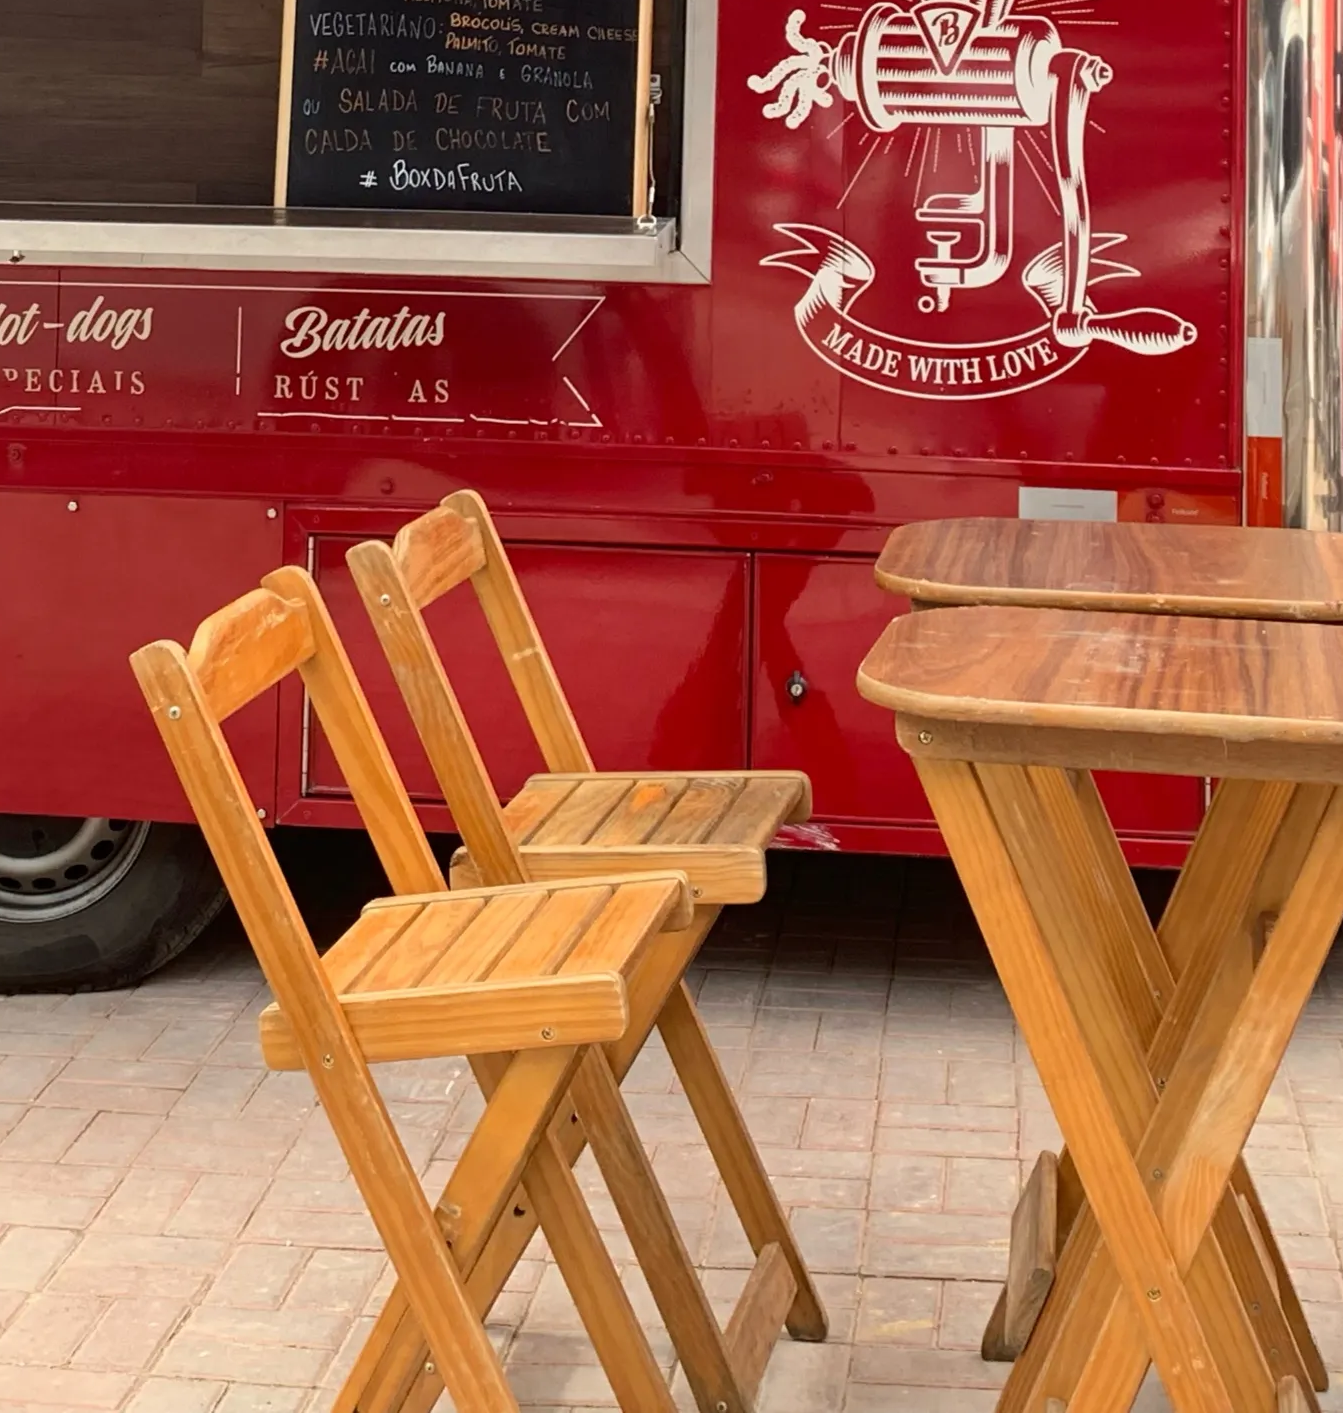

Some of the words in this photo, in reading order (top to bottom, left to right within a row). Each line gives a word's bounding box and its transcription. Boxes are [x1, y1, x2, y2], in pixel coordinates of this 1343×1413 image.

[531, 22, 580, 38] CREAM
[508, 37, 566, 60] TOMATE
[426, 54, 484, 78] BANANA
[521, 64, 594, 90] GRANOLA
[339, 88, 418, 114] SALADA
[434, 92, 462, 115] DE
[476, 97, 546, 125] FRUTA
[566, 98, 610, 123] COM
[305, 128, 372, 155] CALDA
[393, 129, 418, 152] DE
[436, 127, 551, 153] CHOCOLATE
[280, 306, 446, 359] Batatas
[821, 322, 903, 378] MADE
[907, 355, 984, 385] WITH
[986, 337, 1059, 382] LOVE
